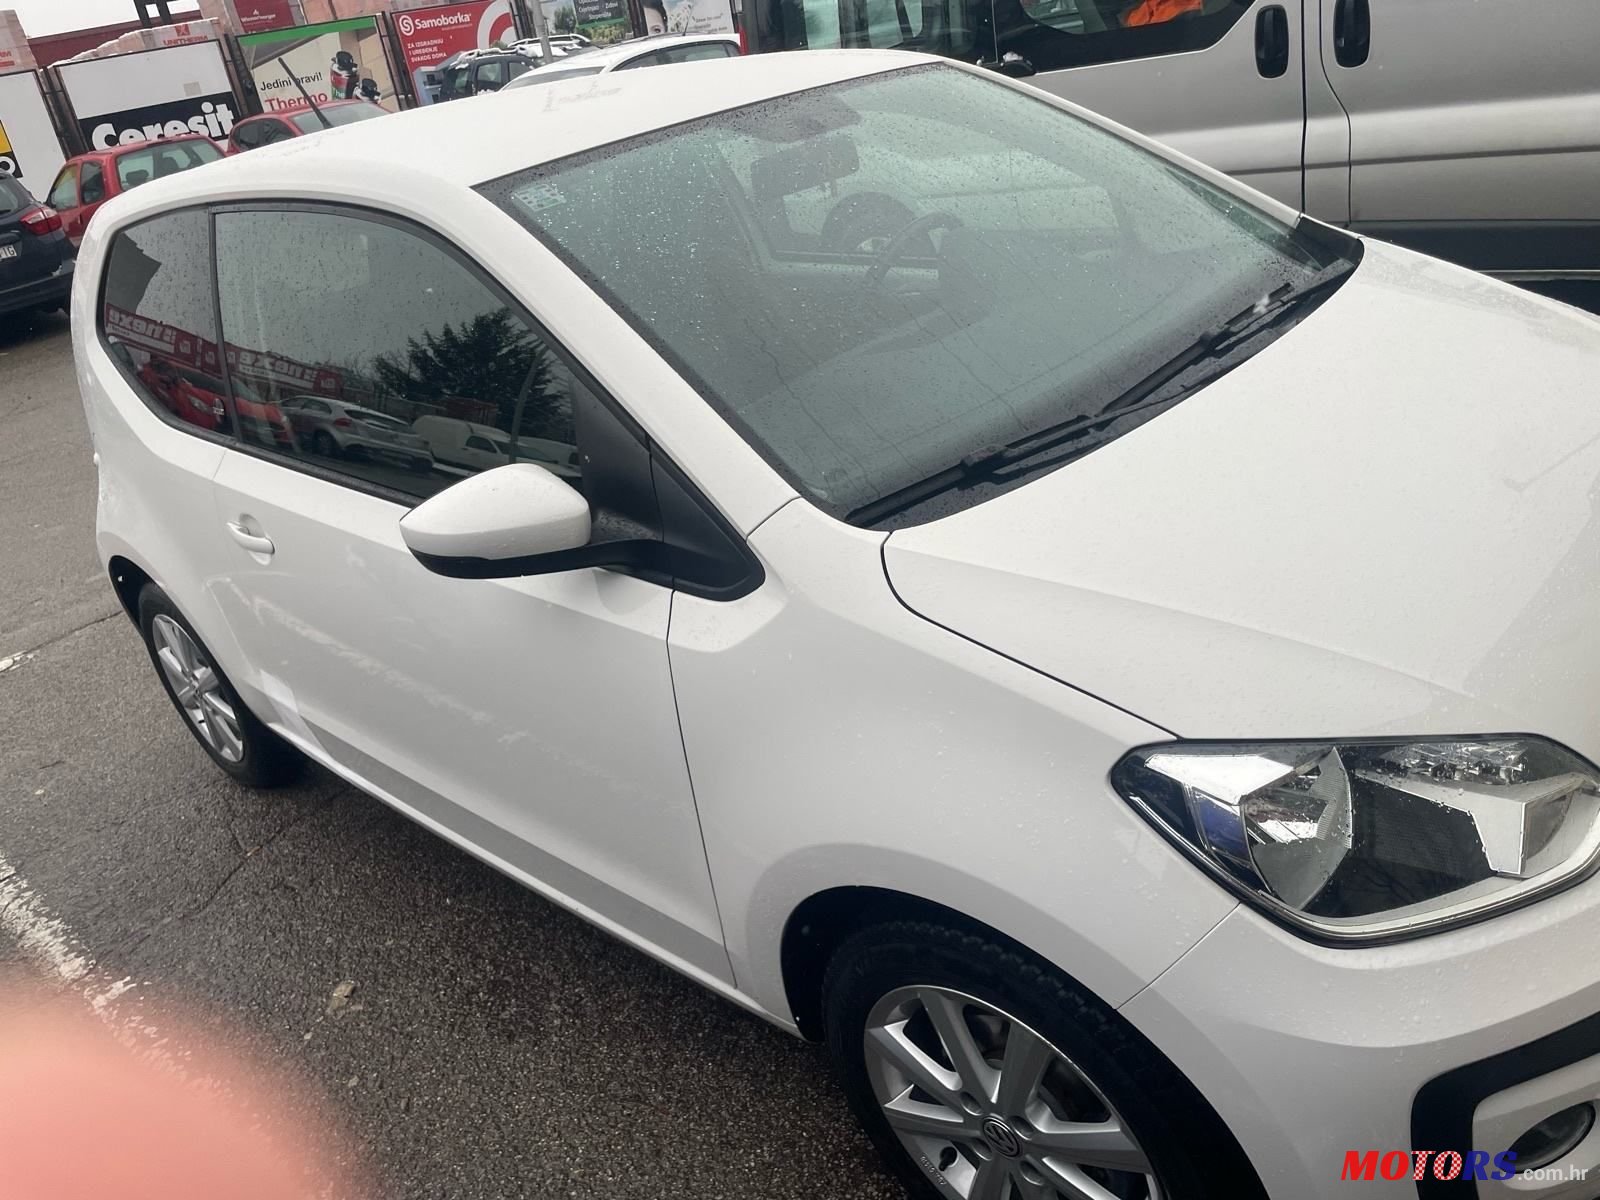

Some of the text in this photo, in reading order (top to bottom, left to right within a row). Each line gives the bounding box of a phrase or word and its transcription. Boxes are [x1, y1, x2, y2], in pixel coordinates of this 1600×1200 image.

[415, 12, 471, 30] Samoborka
[260, 77, 292, 91] Jedini
[92, 102, 234, 151] Ceresit
